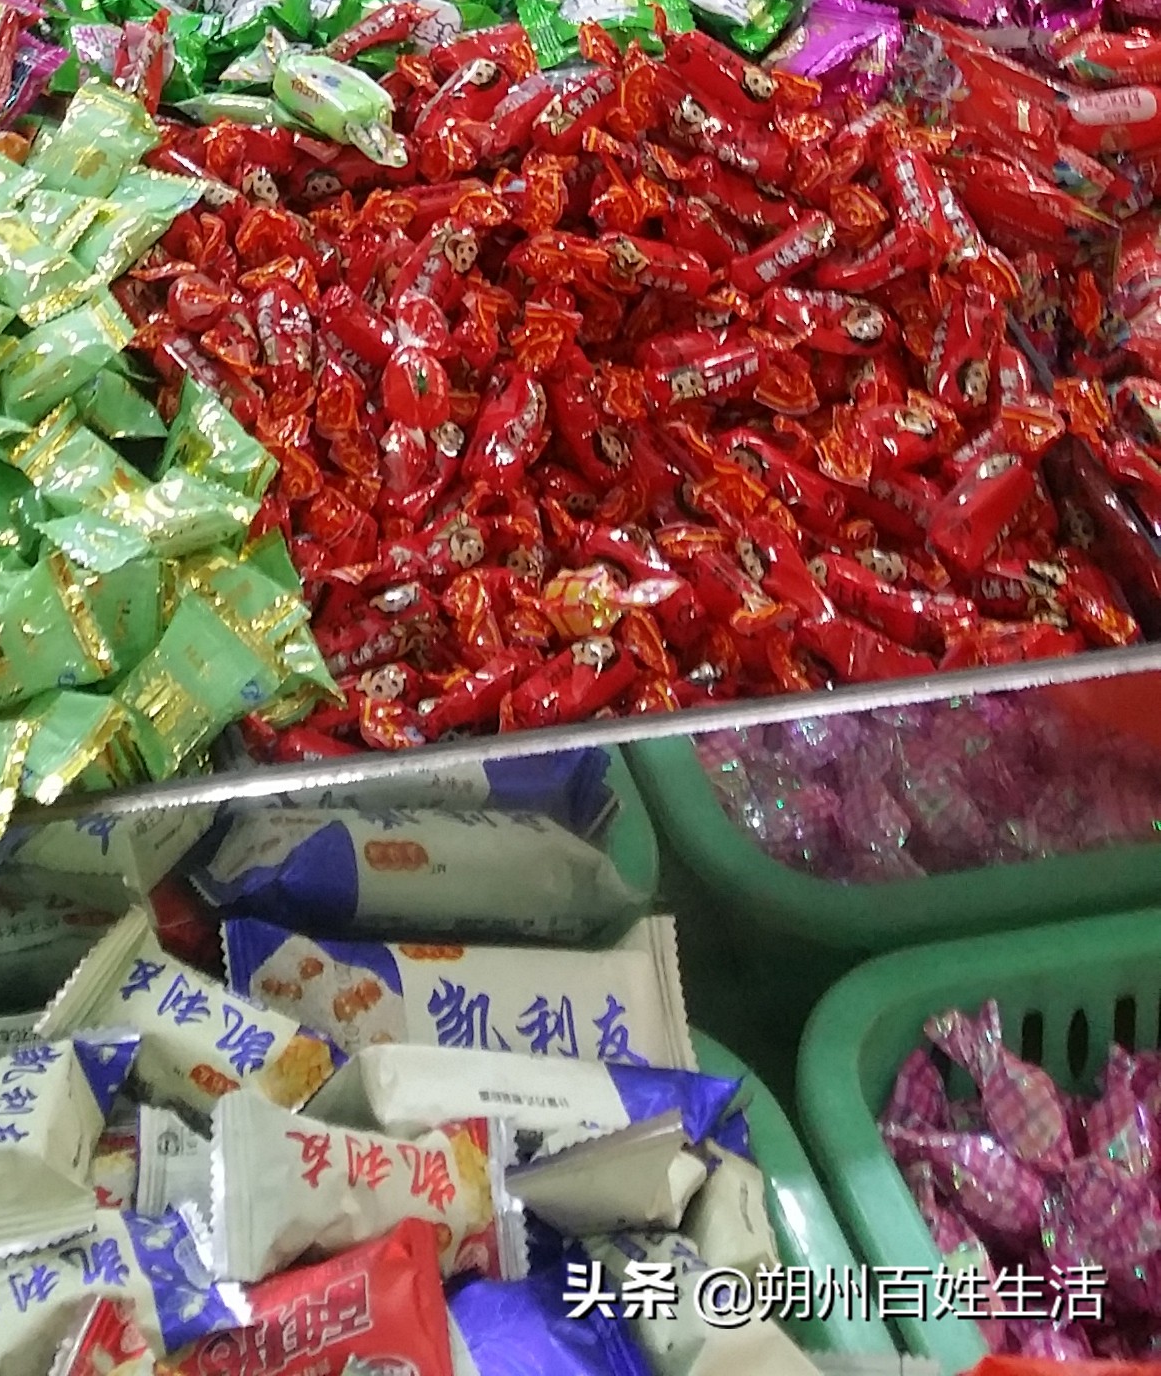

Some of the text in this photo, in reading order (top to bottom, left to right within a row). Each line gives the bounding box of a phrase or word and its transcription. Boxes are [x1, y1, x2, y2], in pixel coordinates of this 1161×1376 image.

[427, 976, 651, 1069] 凯利友
[284, 1131, 457, 1215] 凯利友
